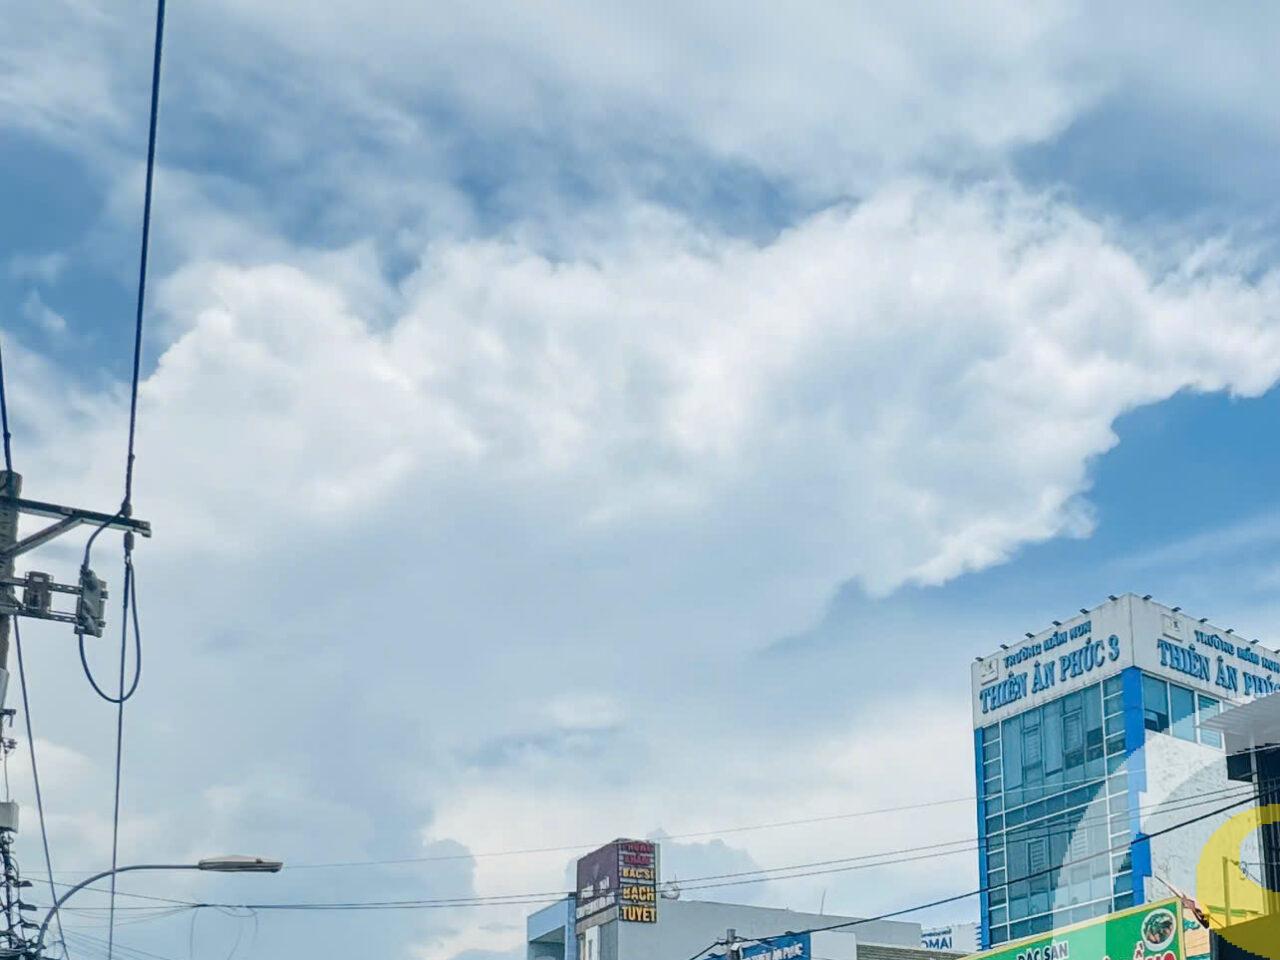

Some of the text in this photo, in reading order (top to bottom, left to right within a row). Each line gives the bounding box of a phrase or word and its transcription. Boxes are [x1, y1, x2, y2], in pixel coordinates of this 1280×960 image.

[979, 634, 1120, 714] THIÊN ÂN PHÚC 3
[1157, 638, 1210, 682] THIÊN
[1215, 655, 1238, 692] ÂN
